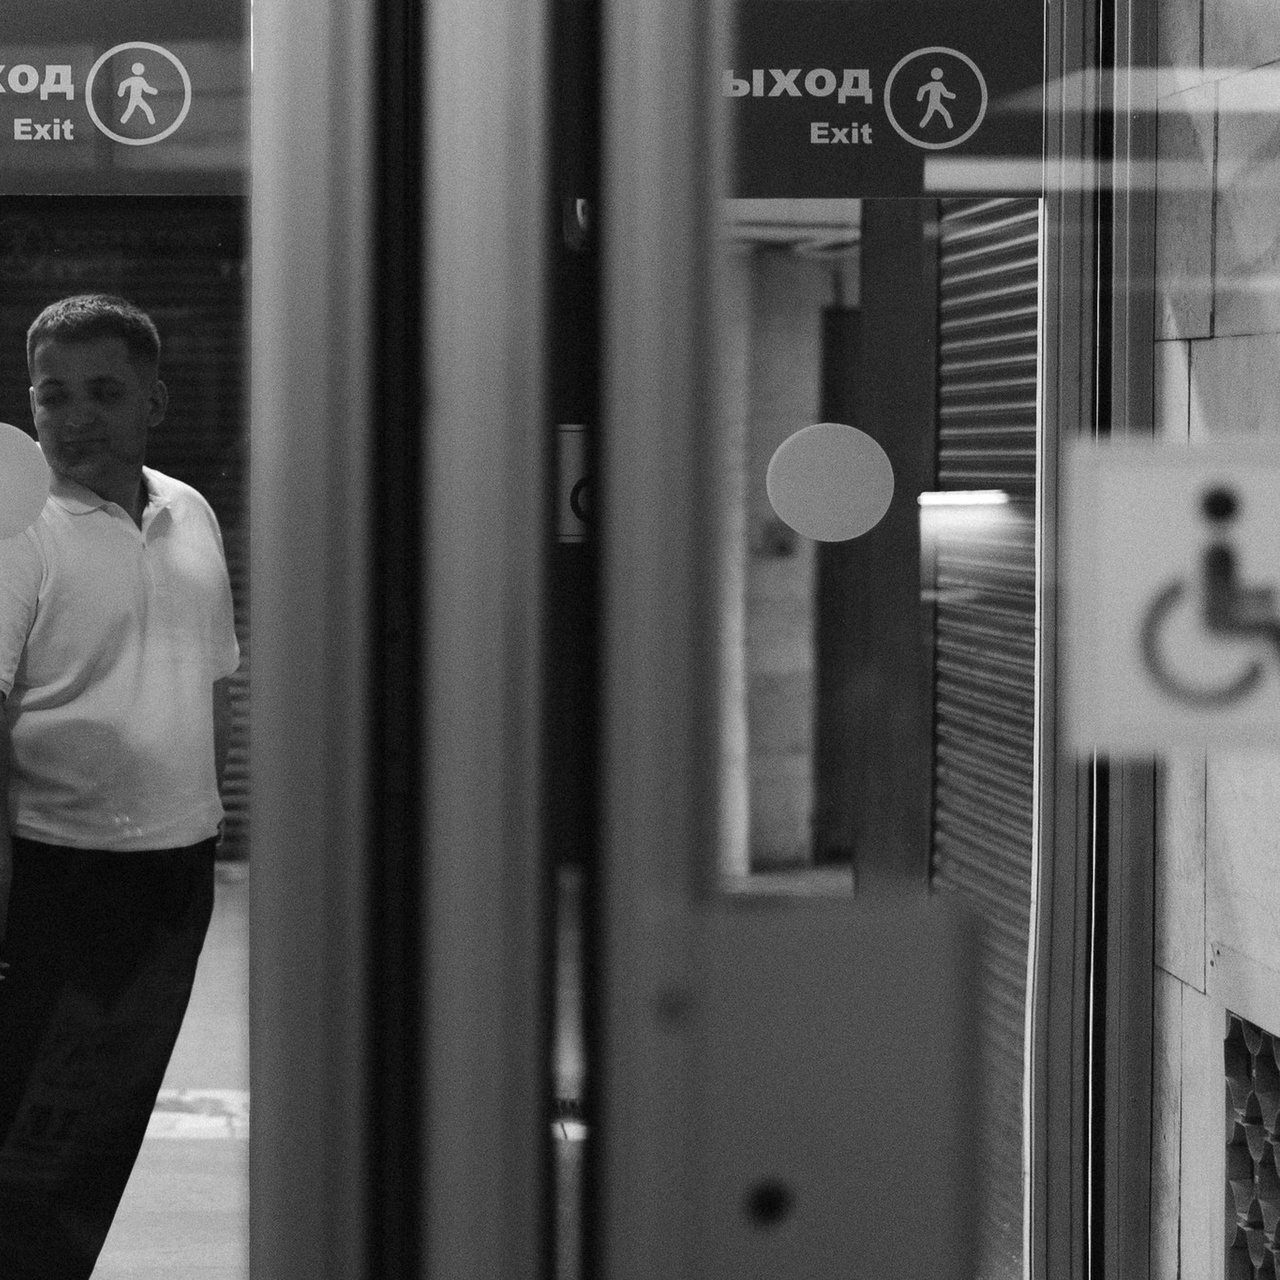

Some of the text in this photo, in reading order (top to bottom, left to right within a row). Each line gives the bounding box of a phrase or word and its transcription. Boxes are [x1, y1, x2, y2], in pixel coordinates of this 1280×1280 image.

[720, 68, 873, 104] ыход
[14, 118, 74, 141] Exit
[810, 122, 873, 144] Exit
